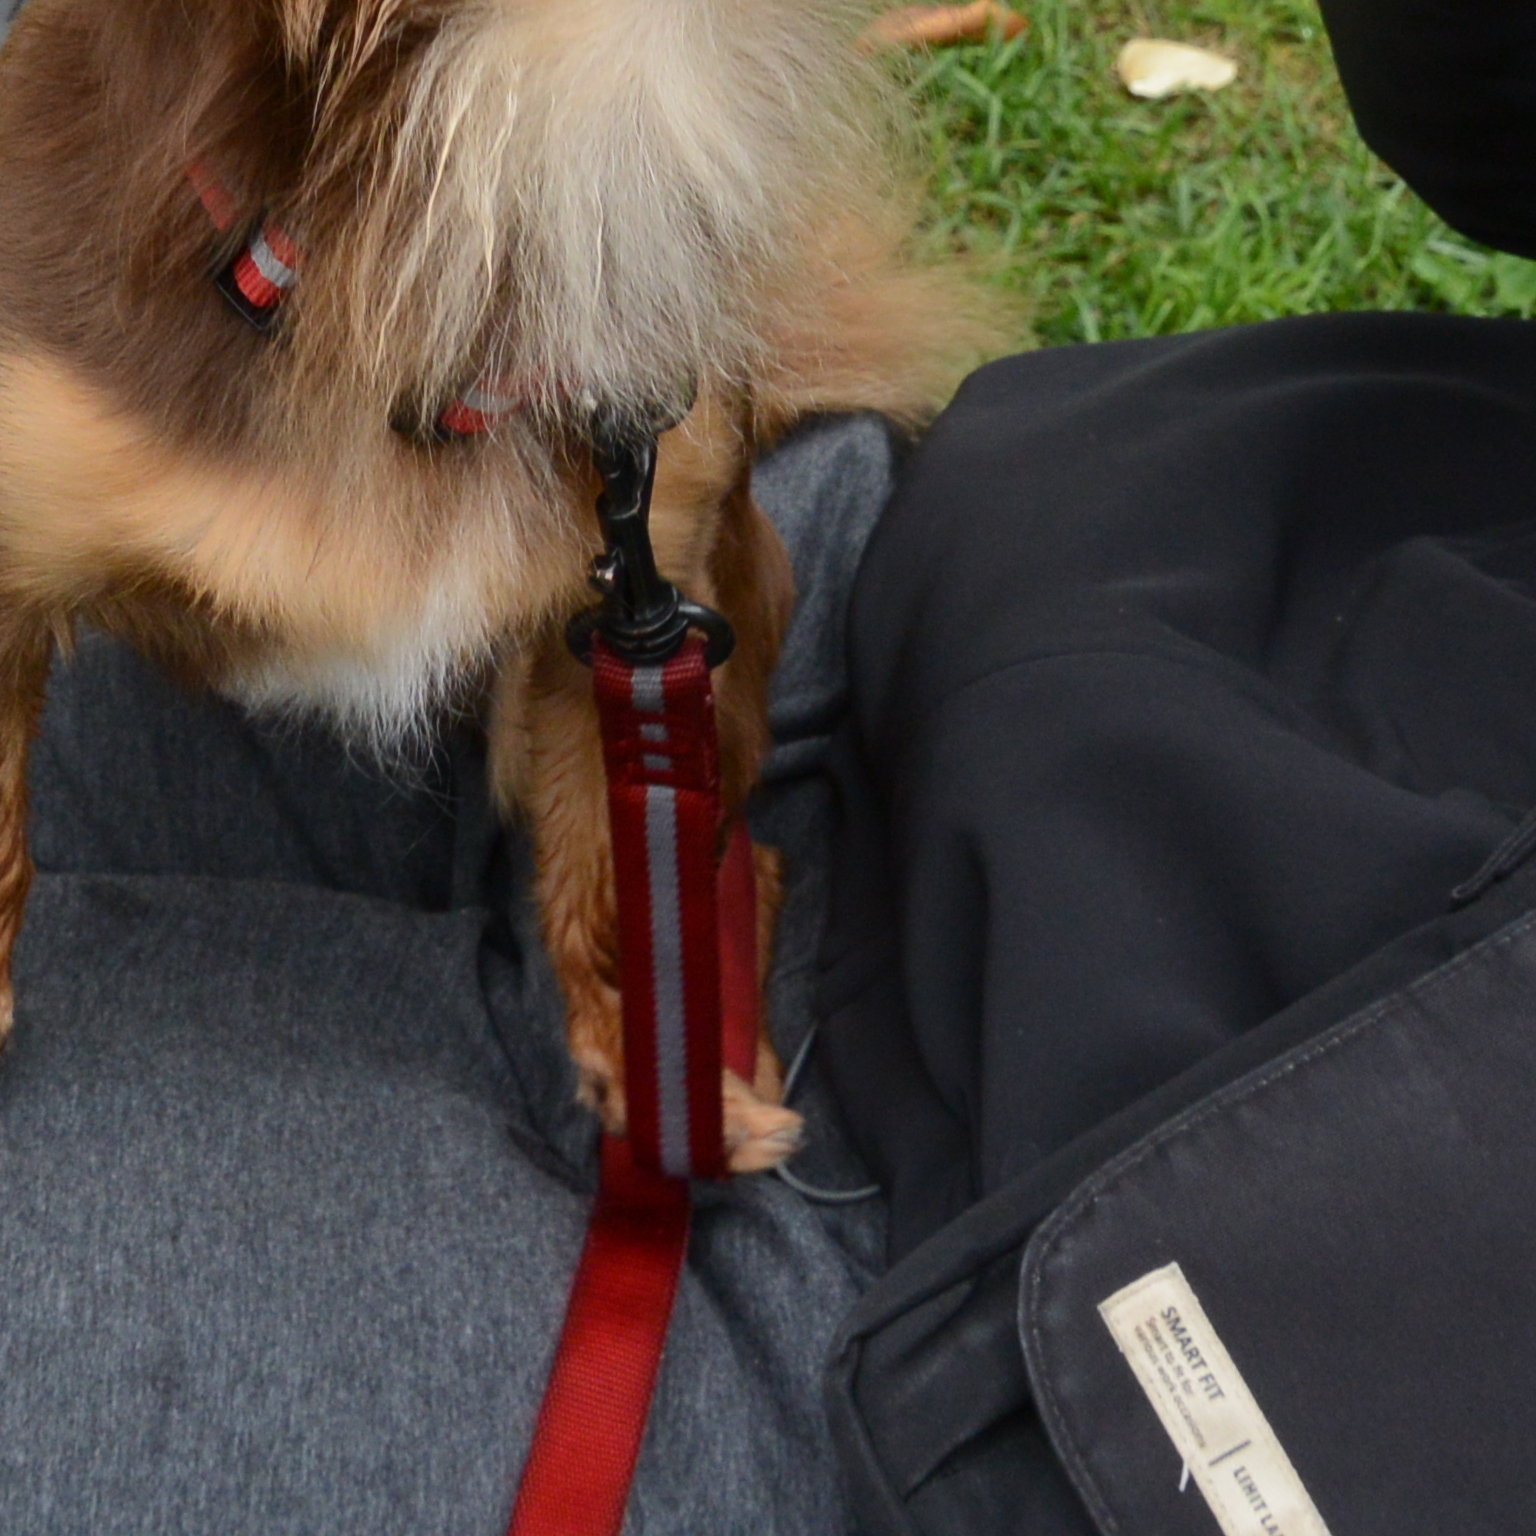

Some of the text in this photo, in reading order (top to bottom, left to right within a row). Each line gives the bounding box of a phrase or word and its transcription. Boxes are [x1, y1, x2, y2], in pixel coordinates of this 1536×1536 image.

[1161, 1306, 1225, 1401] SMART FIT
[1232, 1465, 1284, 1536] LIHIT LA
